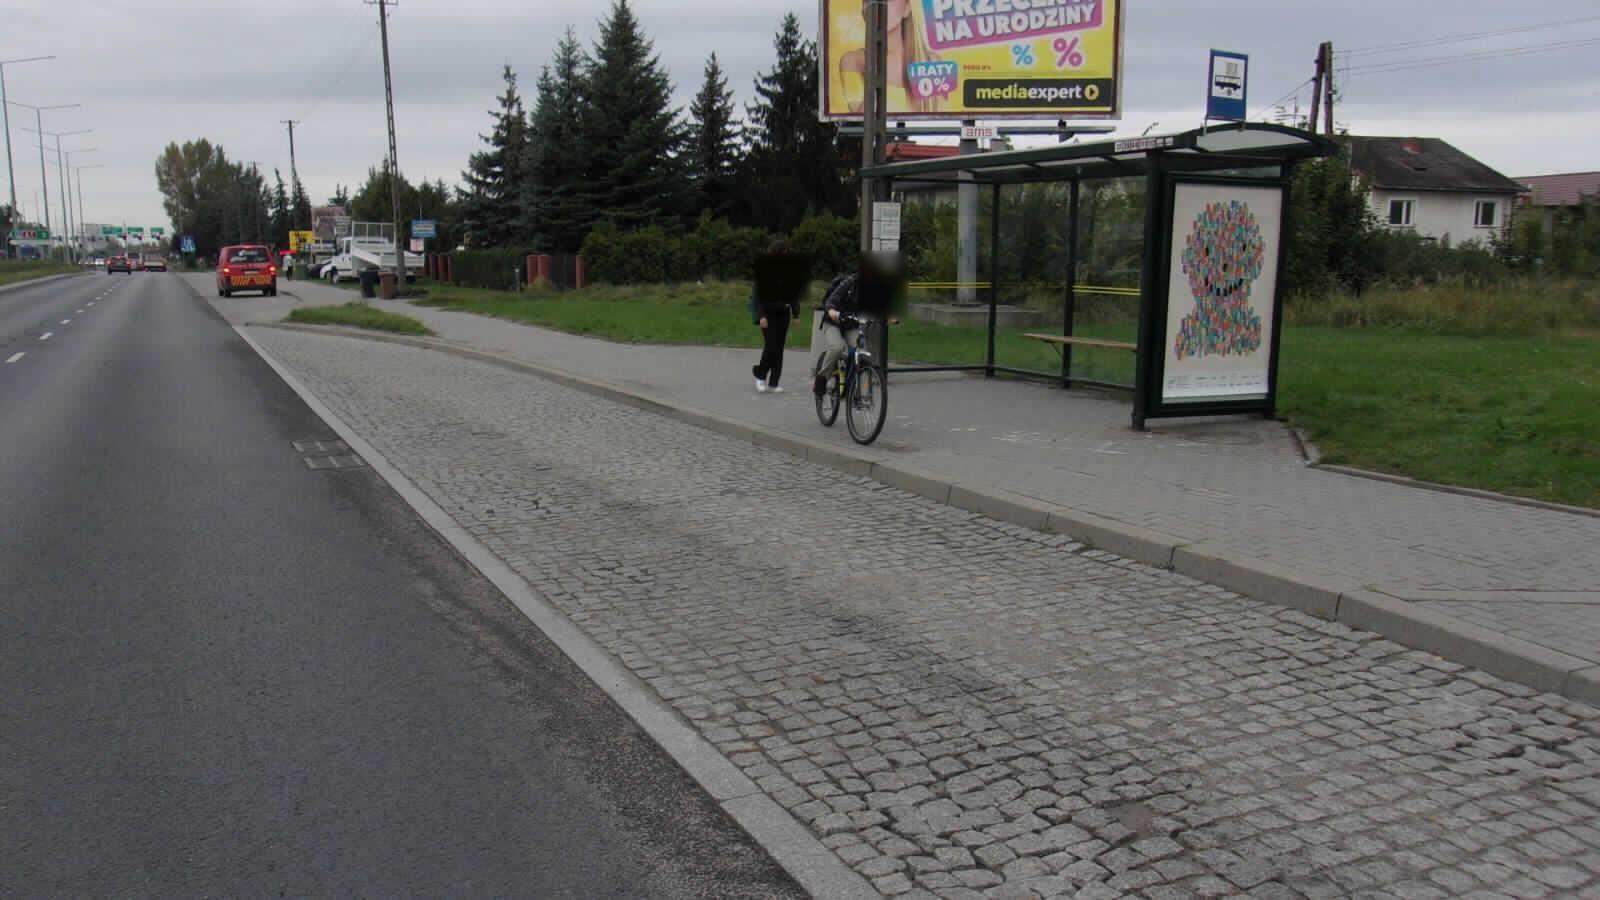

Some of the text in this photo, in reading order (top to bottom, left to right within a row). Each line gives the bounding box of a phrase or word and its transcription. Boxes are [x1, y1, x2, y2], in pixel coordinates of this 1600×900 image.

[935, 4, 1095, 42] NA URODZINY
[1012, 37, 1083, 67] % %
[918, 64, 953, 77] RATY
[918, 77, 949, 96] 0%
[976, 83, 1082, 102] mediaexpert
[966, 127, 992, 137] ams
